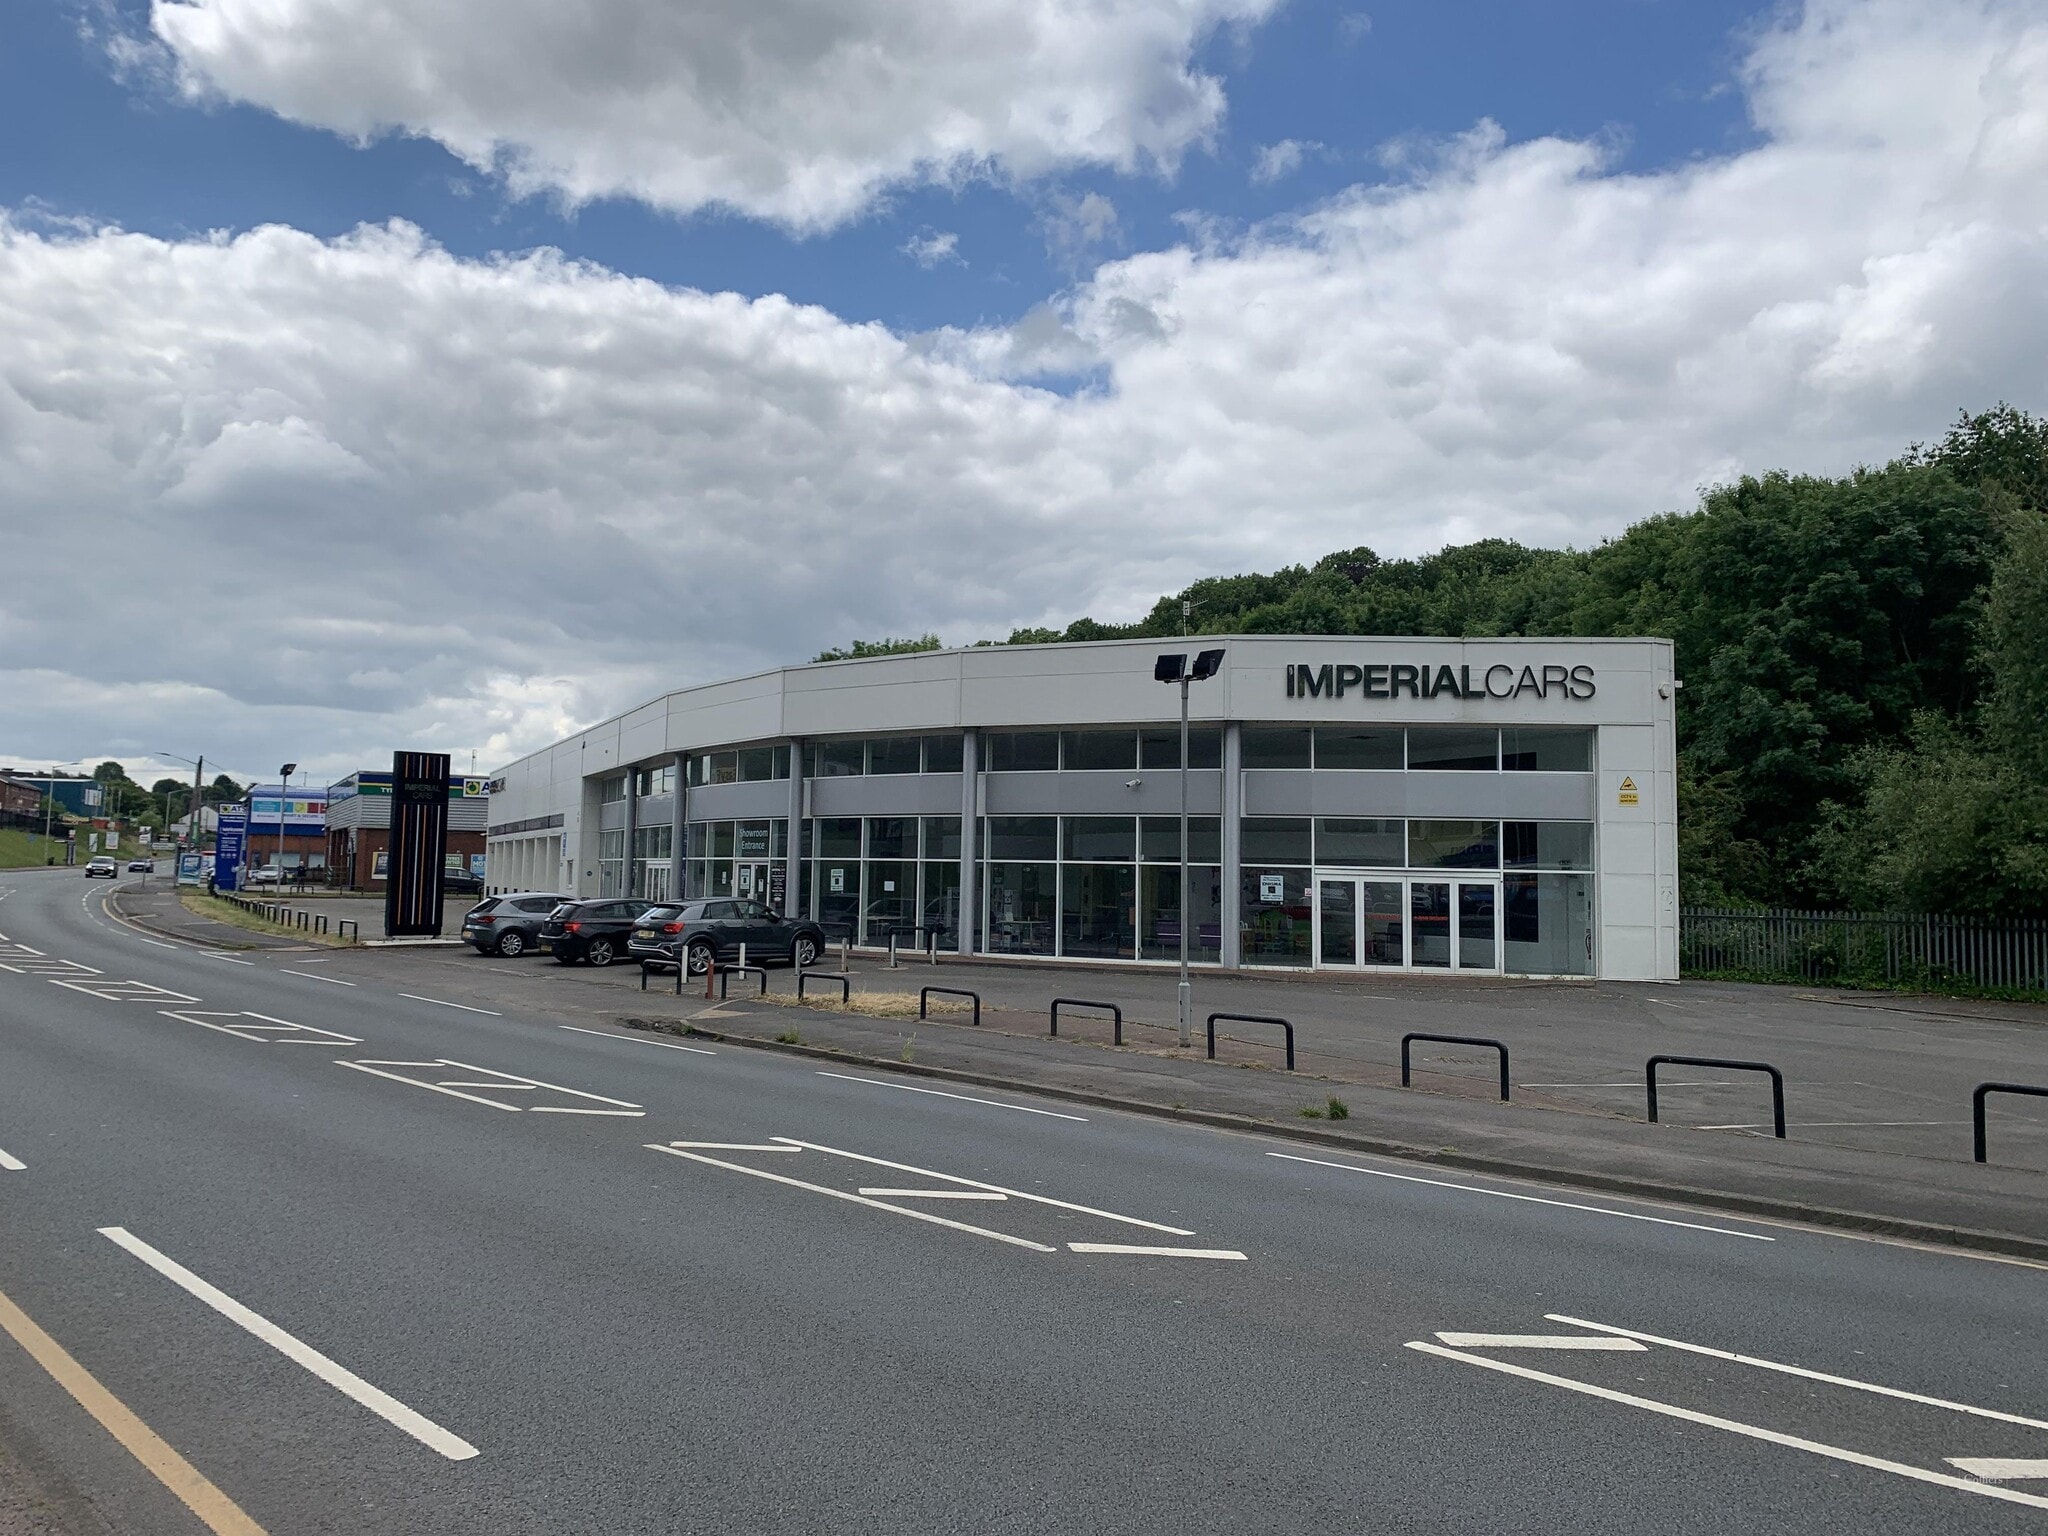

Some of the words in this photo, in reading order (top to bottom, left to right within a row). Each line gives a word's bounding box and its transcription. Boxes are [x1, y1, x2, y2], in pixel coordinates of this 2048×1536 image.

[404, 784, 441, 792] IMPERIAL
[412, 792, 433, 800] CARS
[739, 828, 768, 838] Showroom
[741, 840, 765, 850] Entrance
